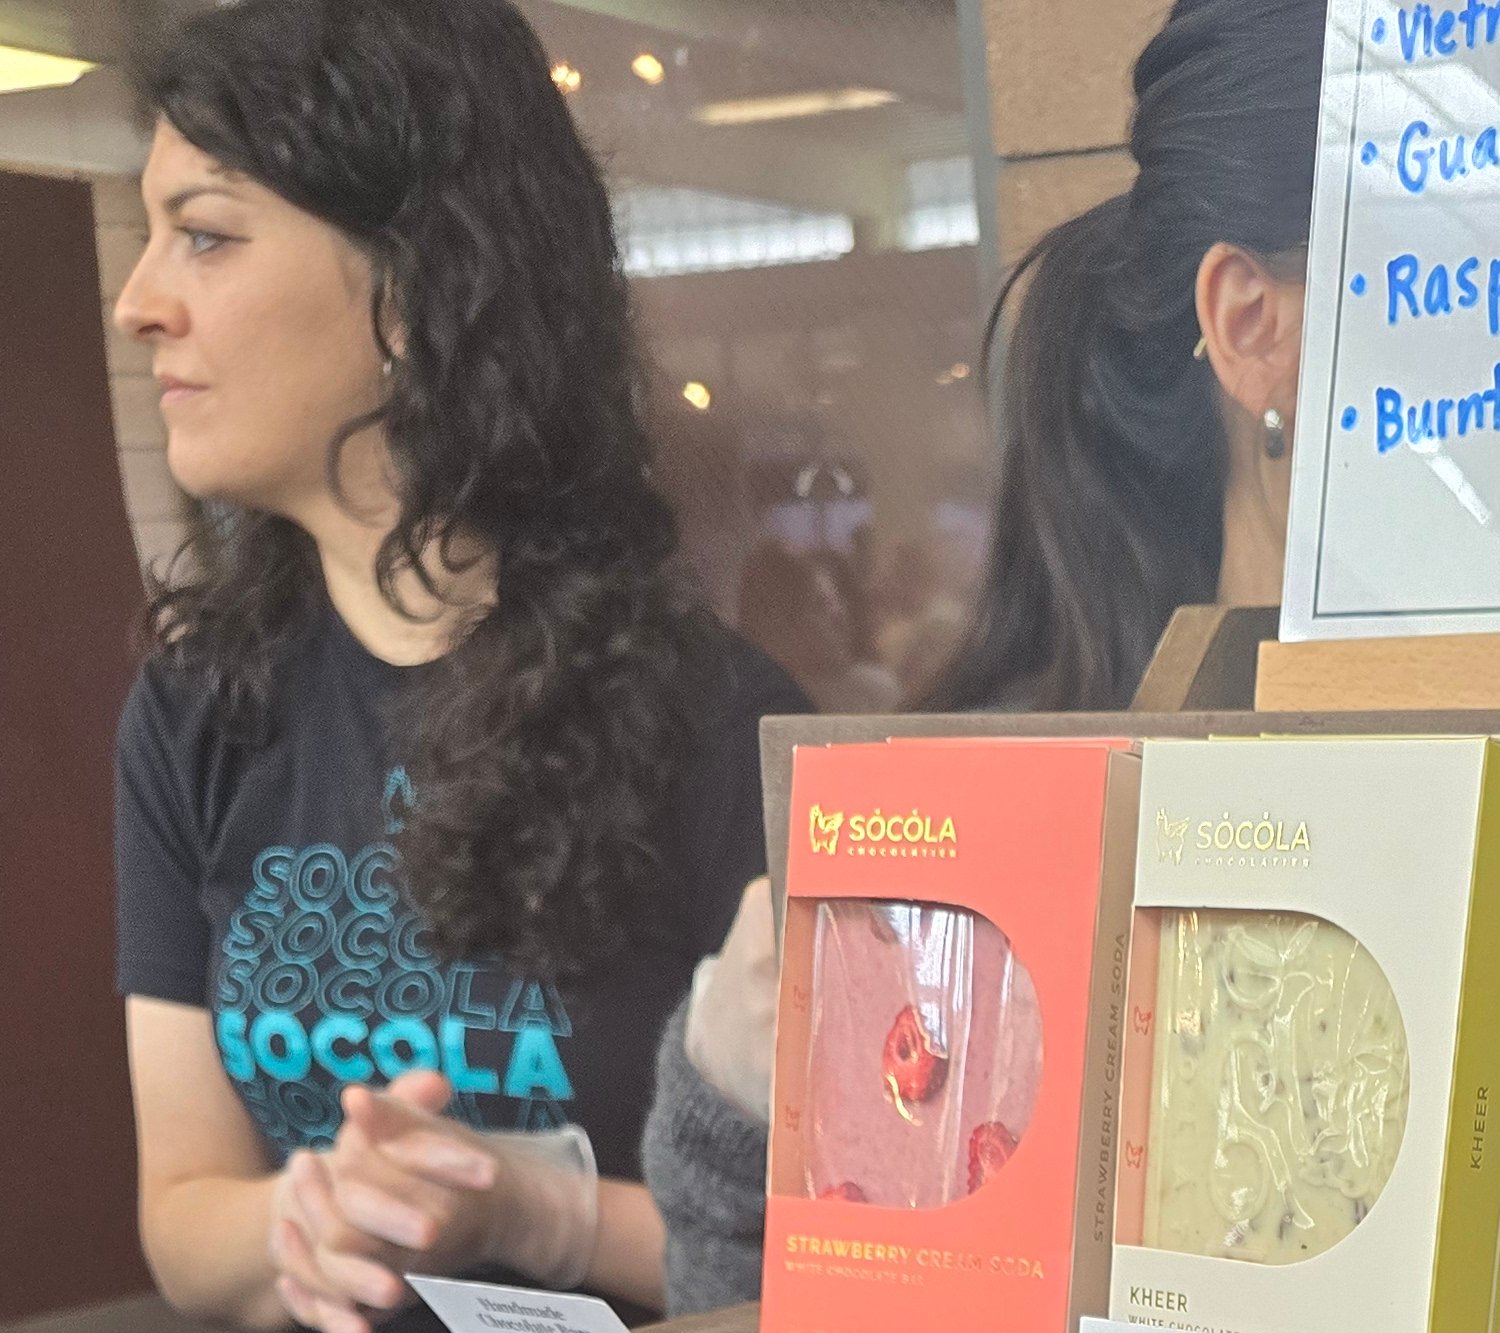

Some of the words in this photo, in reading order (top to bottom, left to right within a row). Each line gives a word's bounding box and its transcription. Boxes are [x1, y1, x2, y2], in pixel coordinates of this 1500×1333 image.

[1111, 933, 1126, 996] SODA
[215, 1008, 575, 1101] SOCOLA
[1105, 1004, 1120, 1083] CREAM
[1094, 1091, 1112, 1243] STRAWBERRY
[1469, 1085, 1489, 1170] KHEER
[786, 1235, 912, 1264] STRAWBERRY
[1129, 1286, 1189, 1313] KHEER
